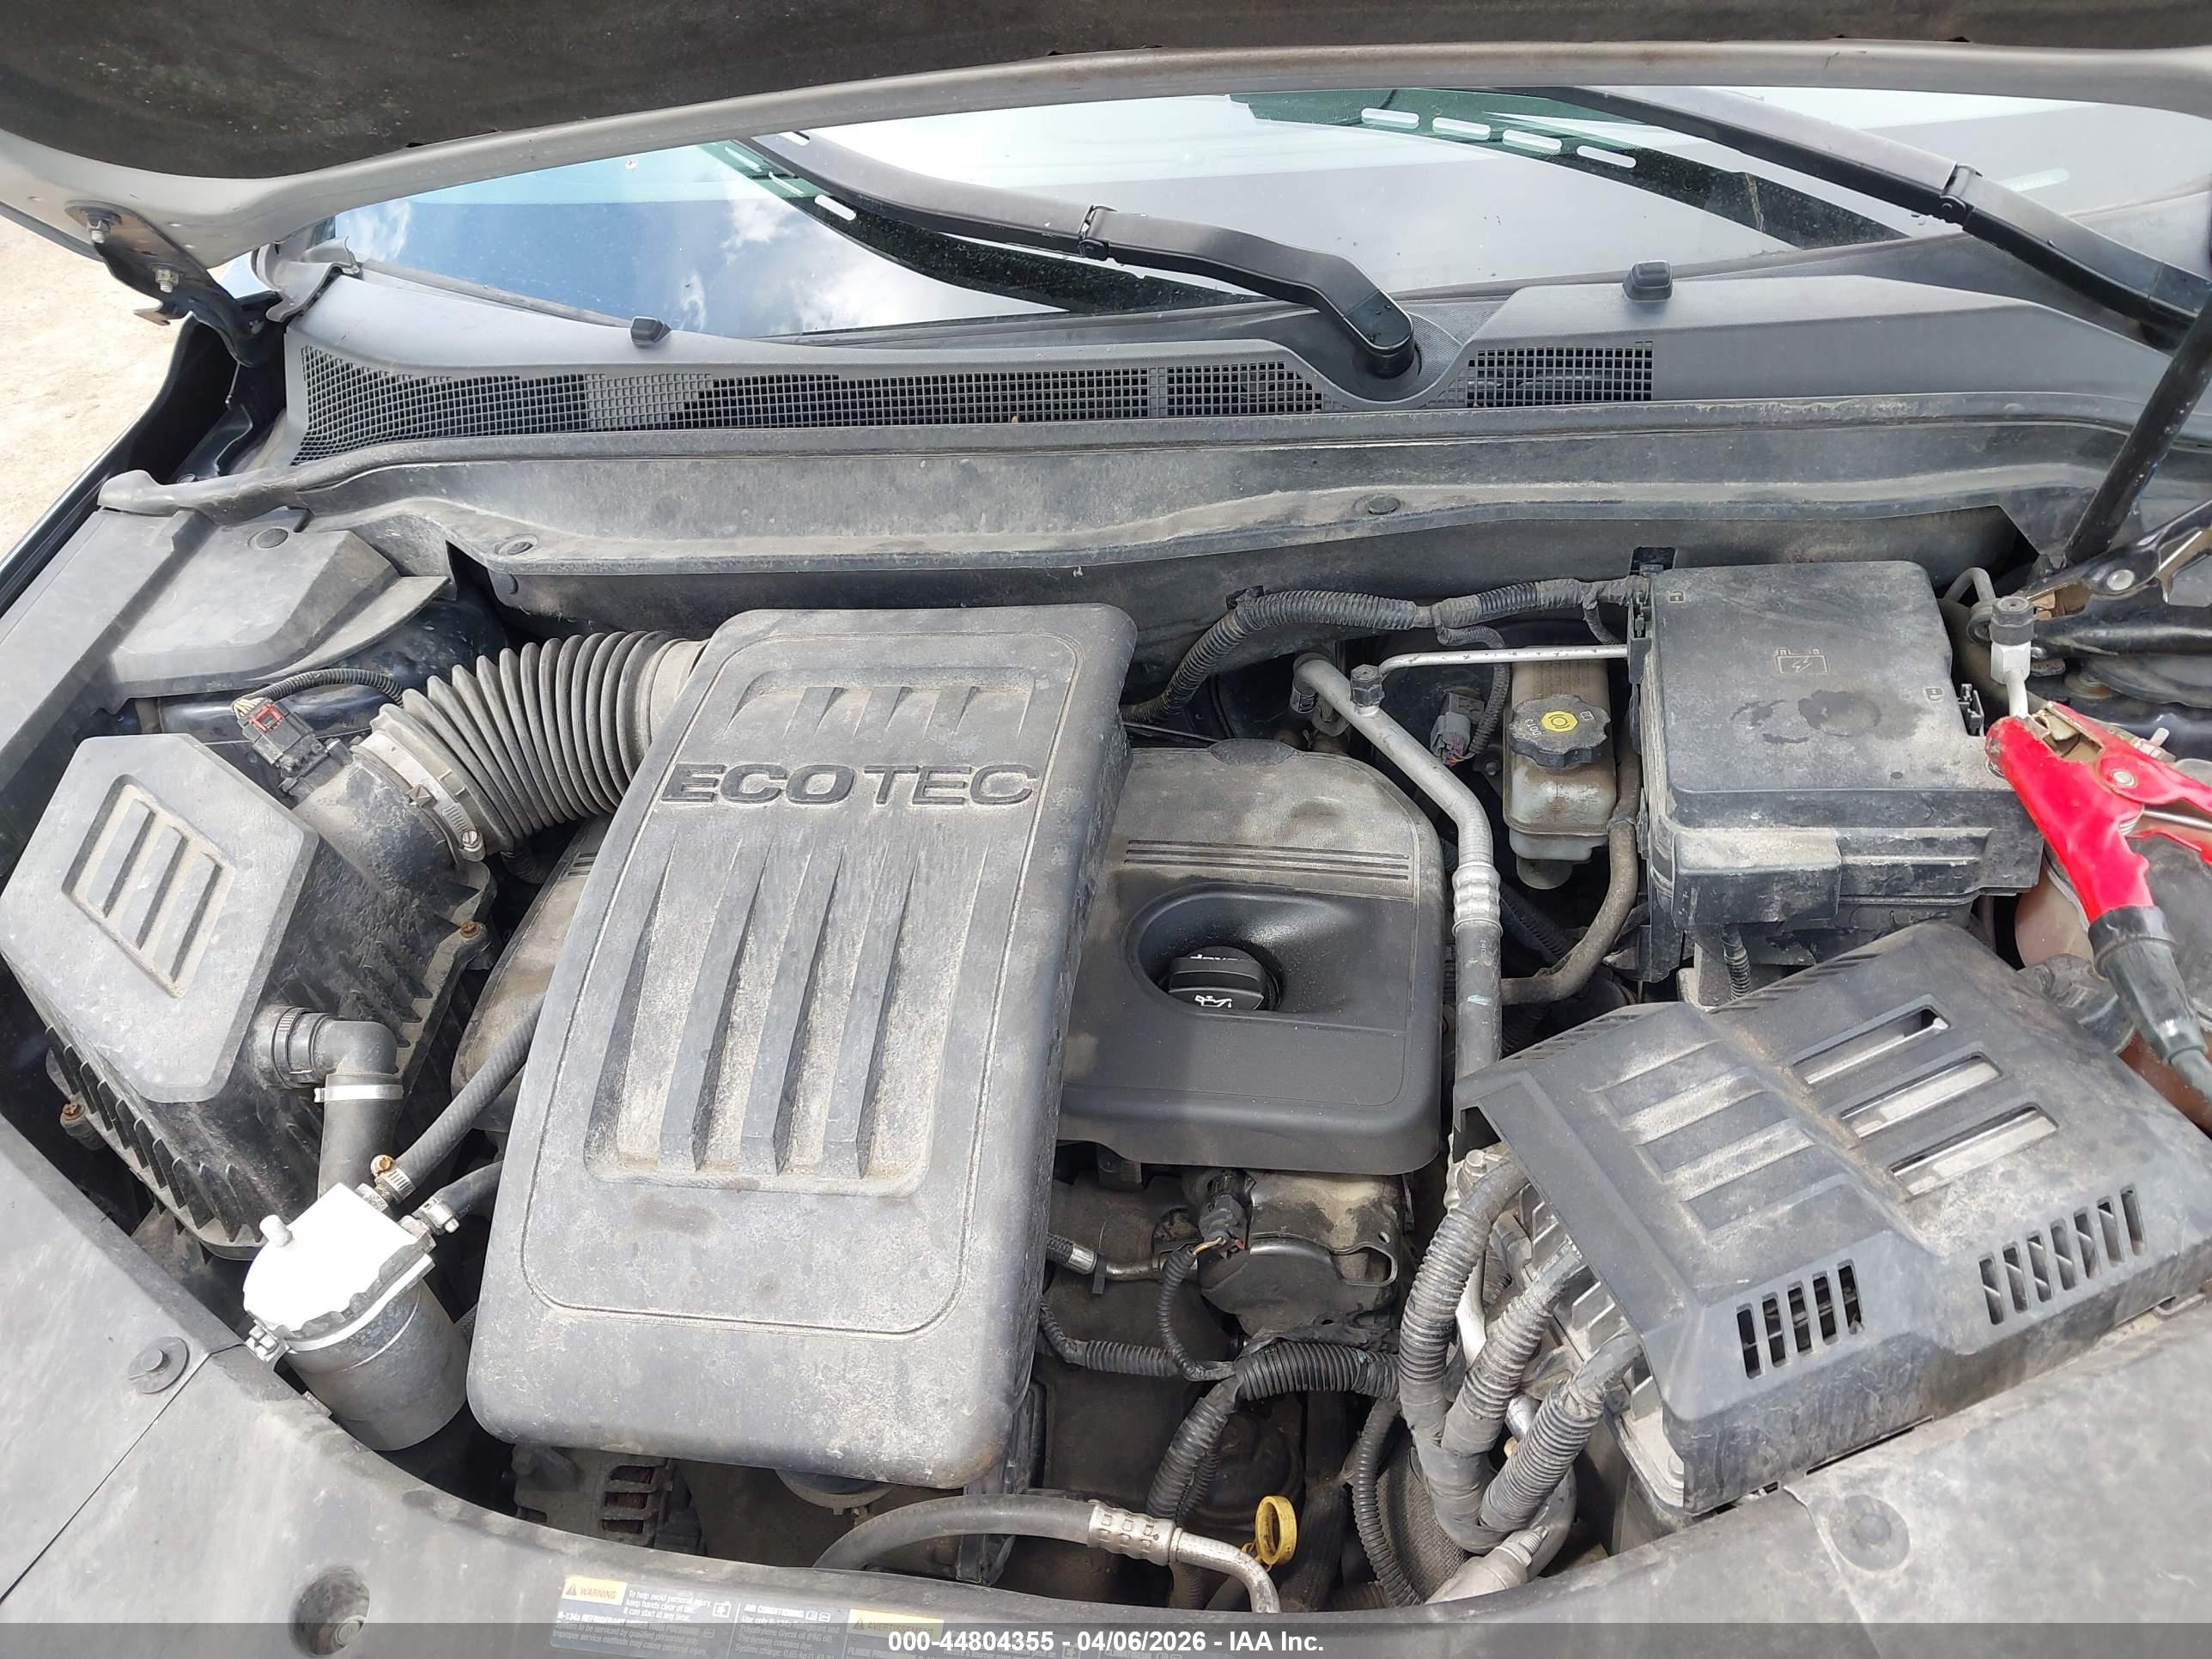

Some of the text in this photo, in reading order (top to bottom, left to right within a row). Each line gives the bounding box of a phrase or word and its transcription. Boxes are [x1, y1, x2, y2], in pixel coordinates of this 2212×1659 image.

[660, 763, 1038, 806] ECOTEC
[580, 1587, 617, 1600] WARNING
[629, 1589, 636, 1598] To
[637, 1591, 649, 1601] help
[651, 1593, 667, 1601] avoid
[668, 1595, 694, 1605] personal
[626, 1599, 641, 1607] keep
[642, 1600, 659, 1609] hands
[661, 1602, 675, 1611] clear
[676, 1604, 684, 1613] of
[744, 1603, 757, 1613] AIR
[557, 1611, 580, 1622] R-134a
[664, 1613, 675, 1621] any
[555, 1619, 578, 1630] System
[594, 1626, 620, 1635] serviced
[620, 1627, 628, 1637] by
[742, 1614, 755, 1623] Use
[755, 1616, 769, 1627] only
[828, 1626, 840, 1634] and
[867, 1621, 934, 1636] AVERTISSEMENT
[553, 1630, 580, 1640] Improper
[580, 1634, 602, 1643] service
[603, 1637, 629, 1646] methods
[629, 1640, 643, 1650] may
[643, 1641, 662, 1650] cause
[662, 1644, 689, 1654] personal
[738, 1633, 814, 1650] The system contains dye.
[778, 1629, 798, 1639] Glycol
[807, 1632, 822, 1643] (PAG
[735, 1644, 759, 1654] System
[759, 1647, 782, 1657] charge:
